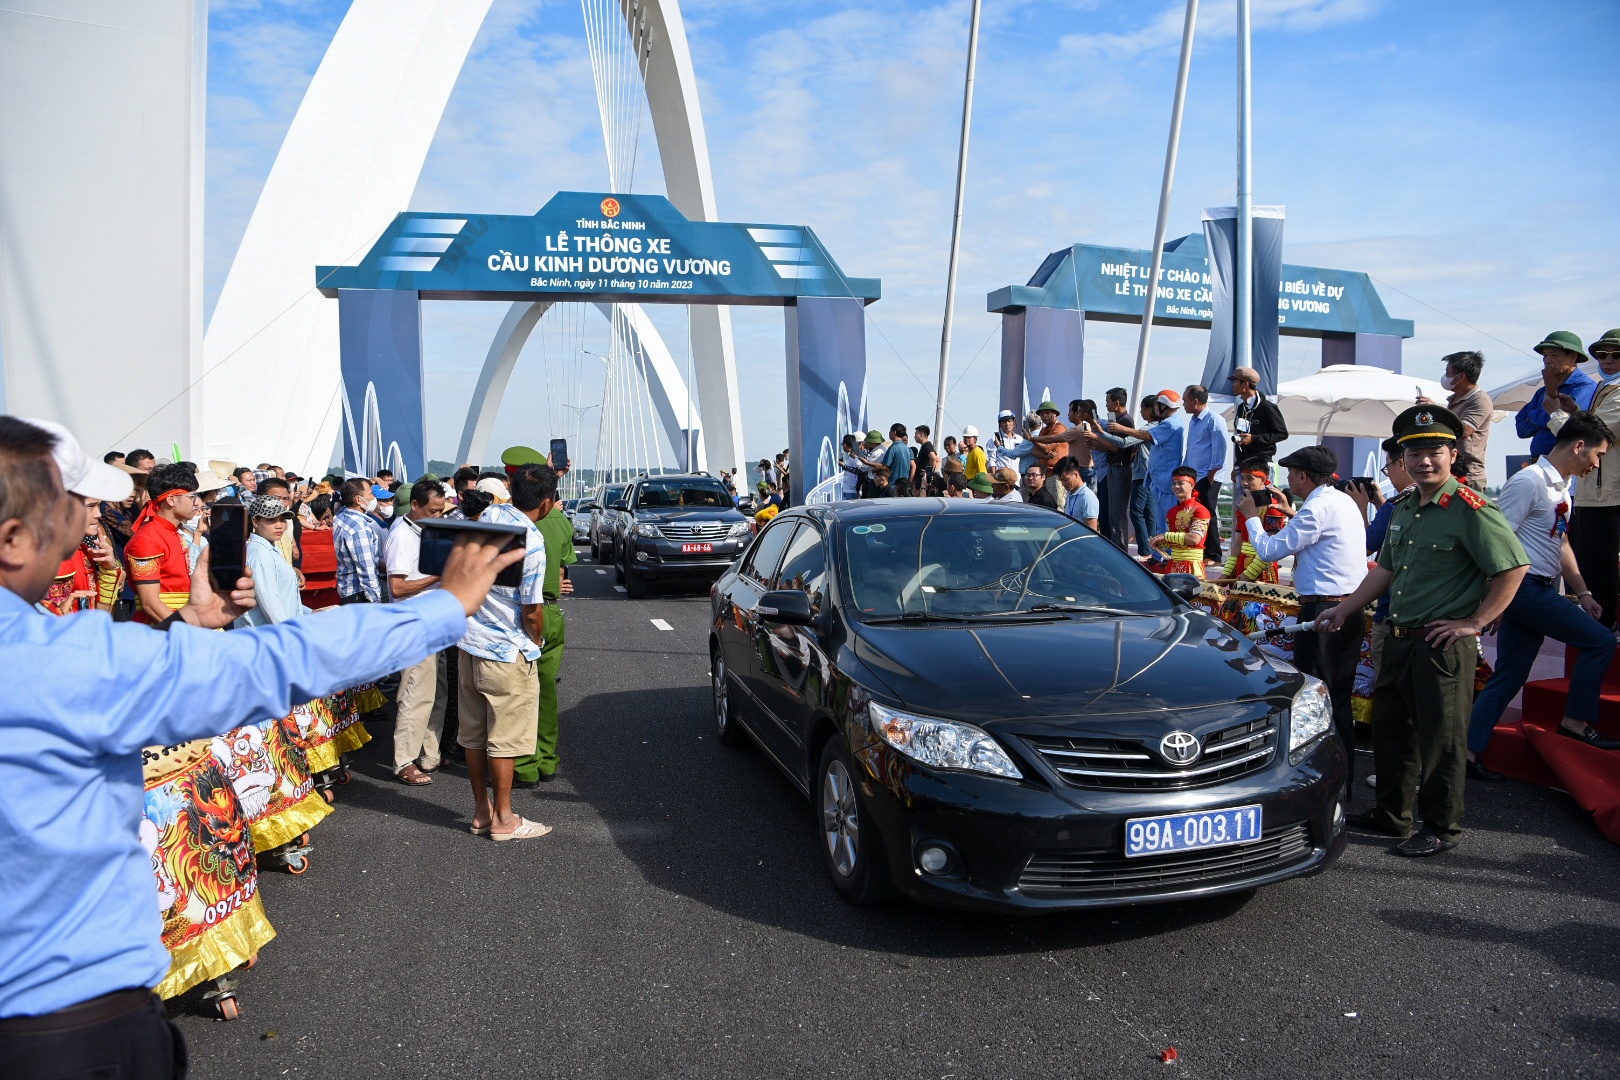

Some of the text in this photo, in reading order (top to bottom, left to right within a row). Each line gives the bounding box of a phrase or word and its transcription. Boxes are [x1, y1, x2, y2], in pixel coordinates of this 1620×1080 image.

[576, 218, 646, 231] TỈNH BẮC NINH
[546, 231, 671, 254] LỄ THÔNG XE
[488, 250, 731, 275] CẦU KINH DƯƠNG VƯƠNG
[530, 277, 693, 290] Bắc Ninh, ngày 11 tháng 10 năm 2023
[1101, 262, 1138, 280] NHIỆT
[1140, 267, 1166, 280] LIT
[1167, 269, 1200, 284] CHÀO
[1327, 286, 1344, 300] DỰ
[1115, 280, 1130, 296] LỄ
[1133, 284, 1174, 299] THNG
[1176, 288, 1191, 301] XE
[1292, 299, 1330, 314] VƯƠNG
[1166, 305, 1179, 314] Bắc
[1180, 307, 1197, 317] Ninh,
[1129, 809, 1256, 852] 99A-003.11
